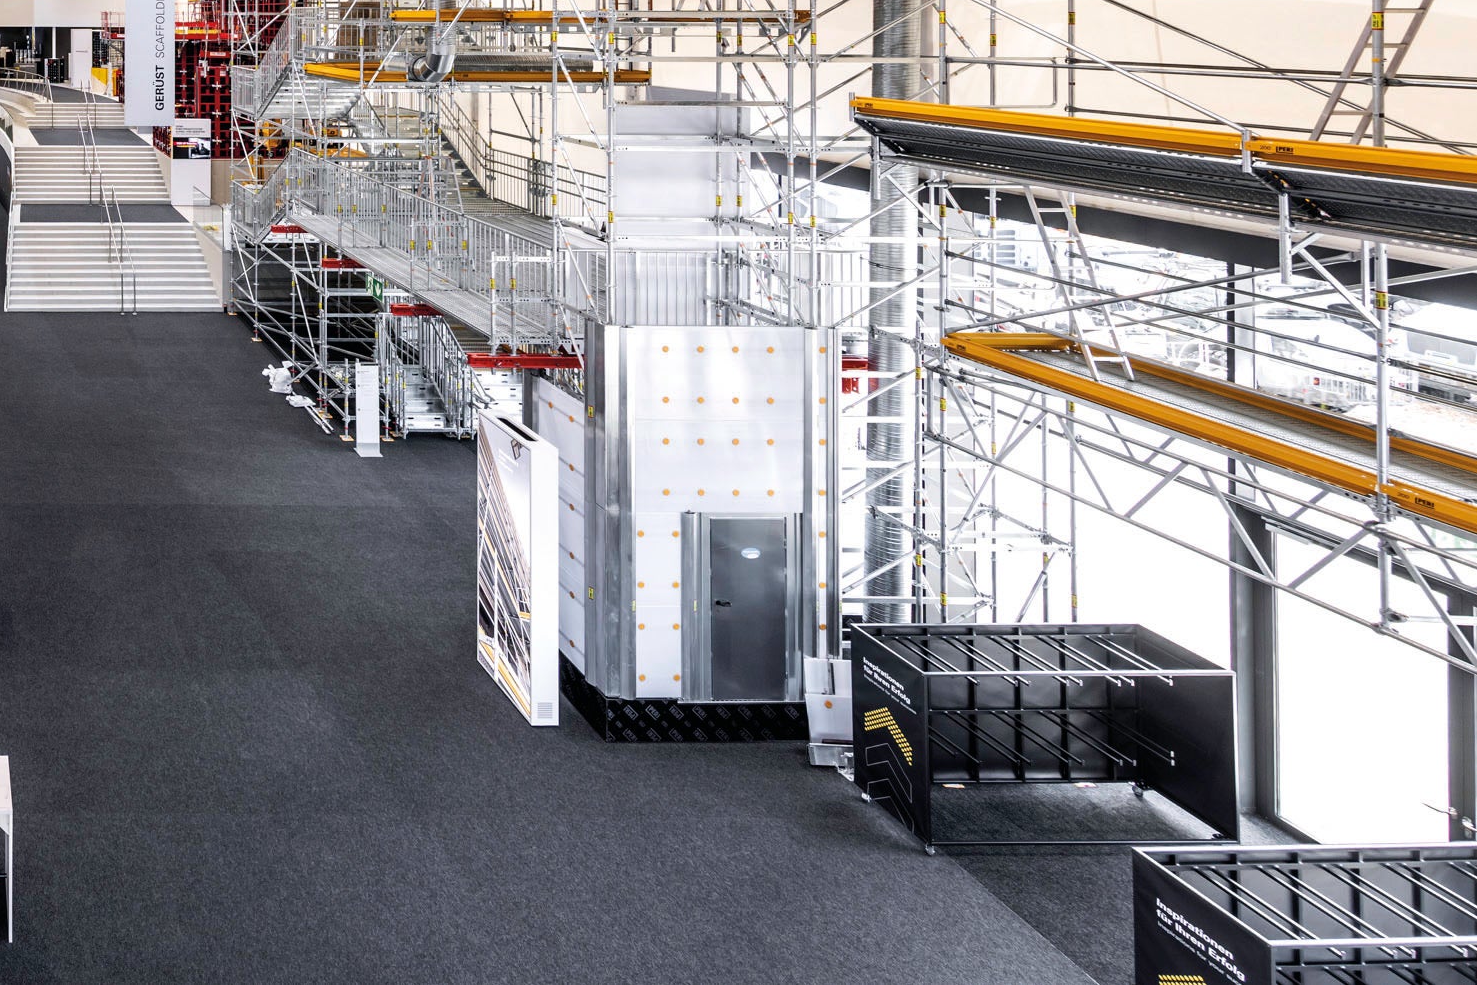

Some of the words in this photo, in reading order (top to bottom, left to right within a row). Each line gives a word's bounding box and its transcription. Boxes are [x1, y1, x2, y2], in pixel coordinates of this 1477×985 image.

[153, 65, 164, 111] GERÜST
[863, 656, 904, 691] Inspirationen
[873, 671, 890, 688] Ihren
[890, 684, 911, 705] Erfolg
[1156, 897, 1234, 961] Inspirationen
[1156, 908, 1174, 926] für
[1174, 922, 1206, 951] Ihren
[1208, 946, 1246, 982] Erfolg
